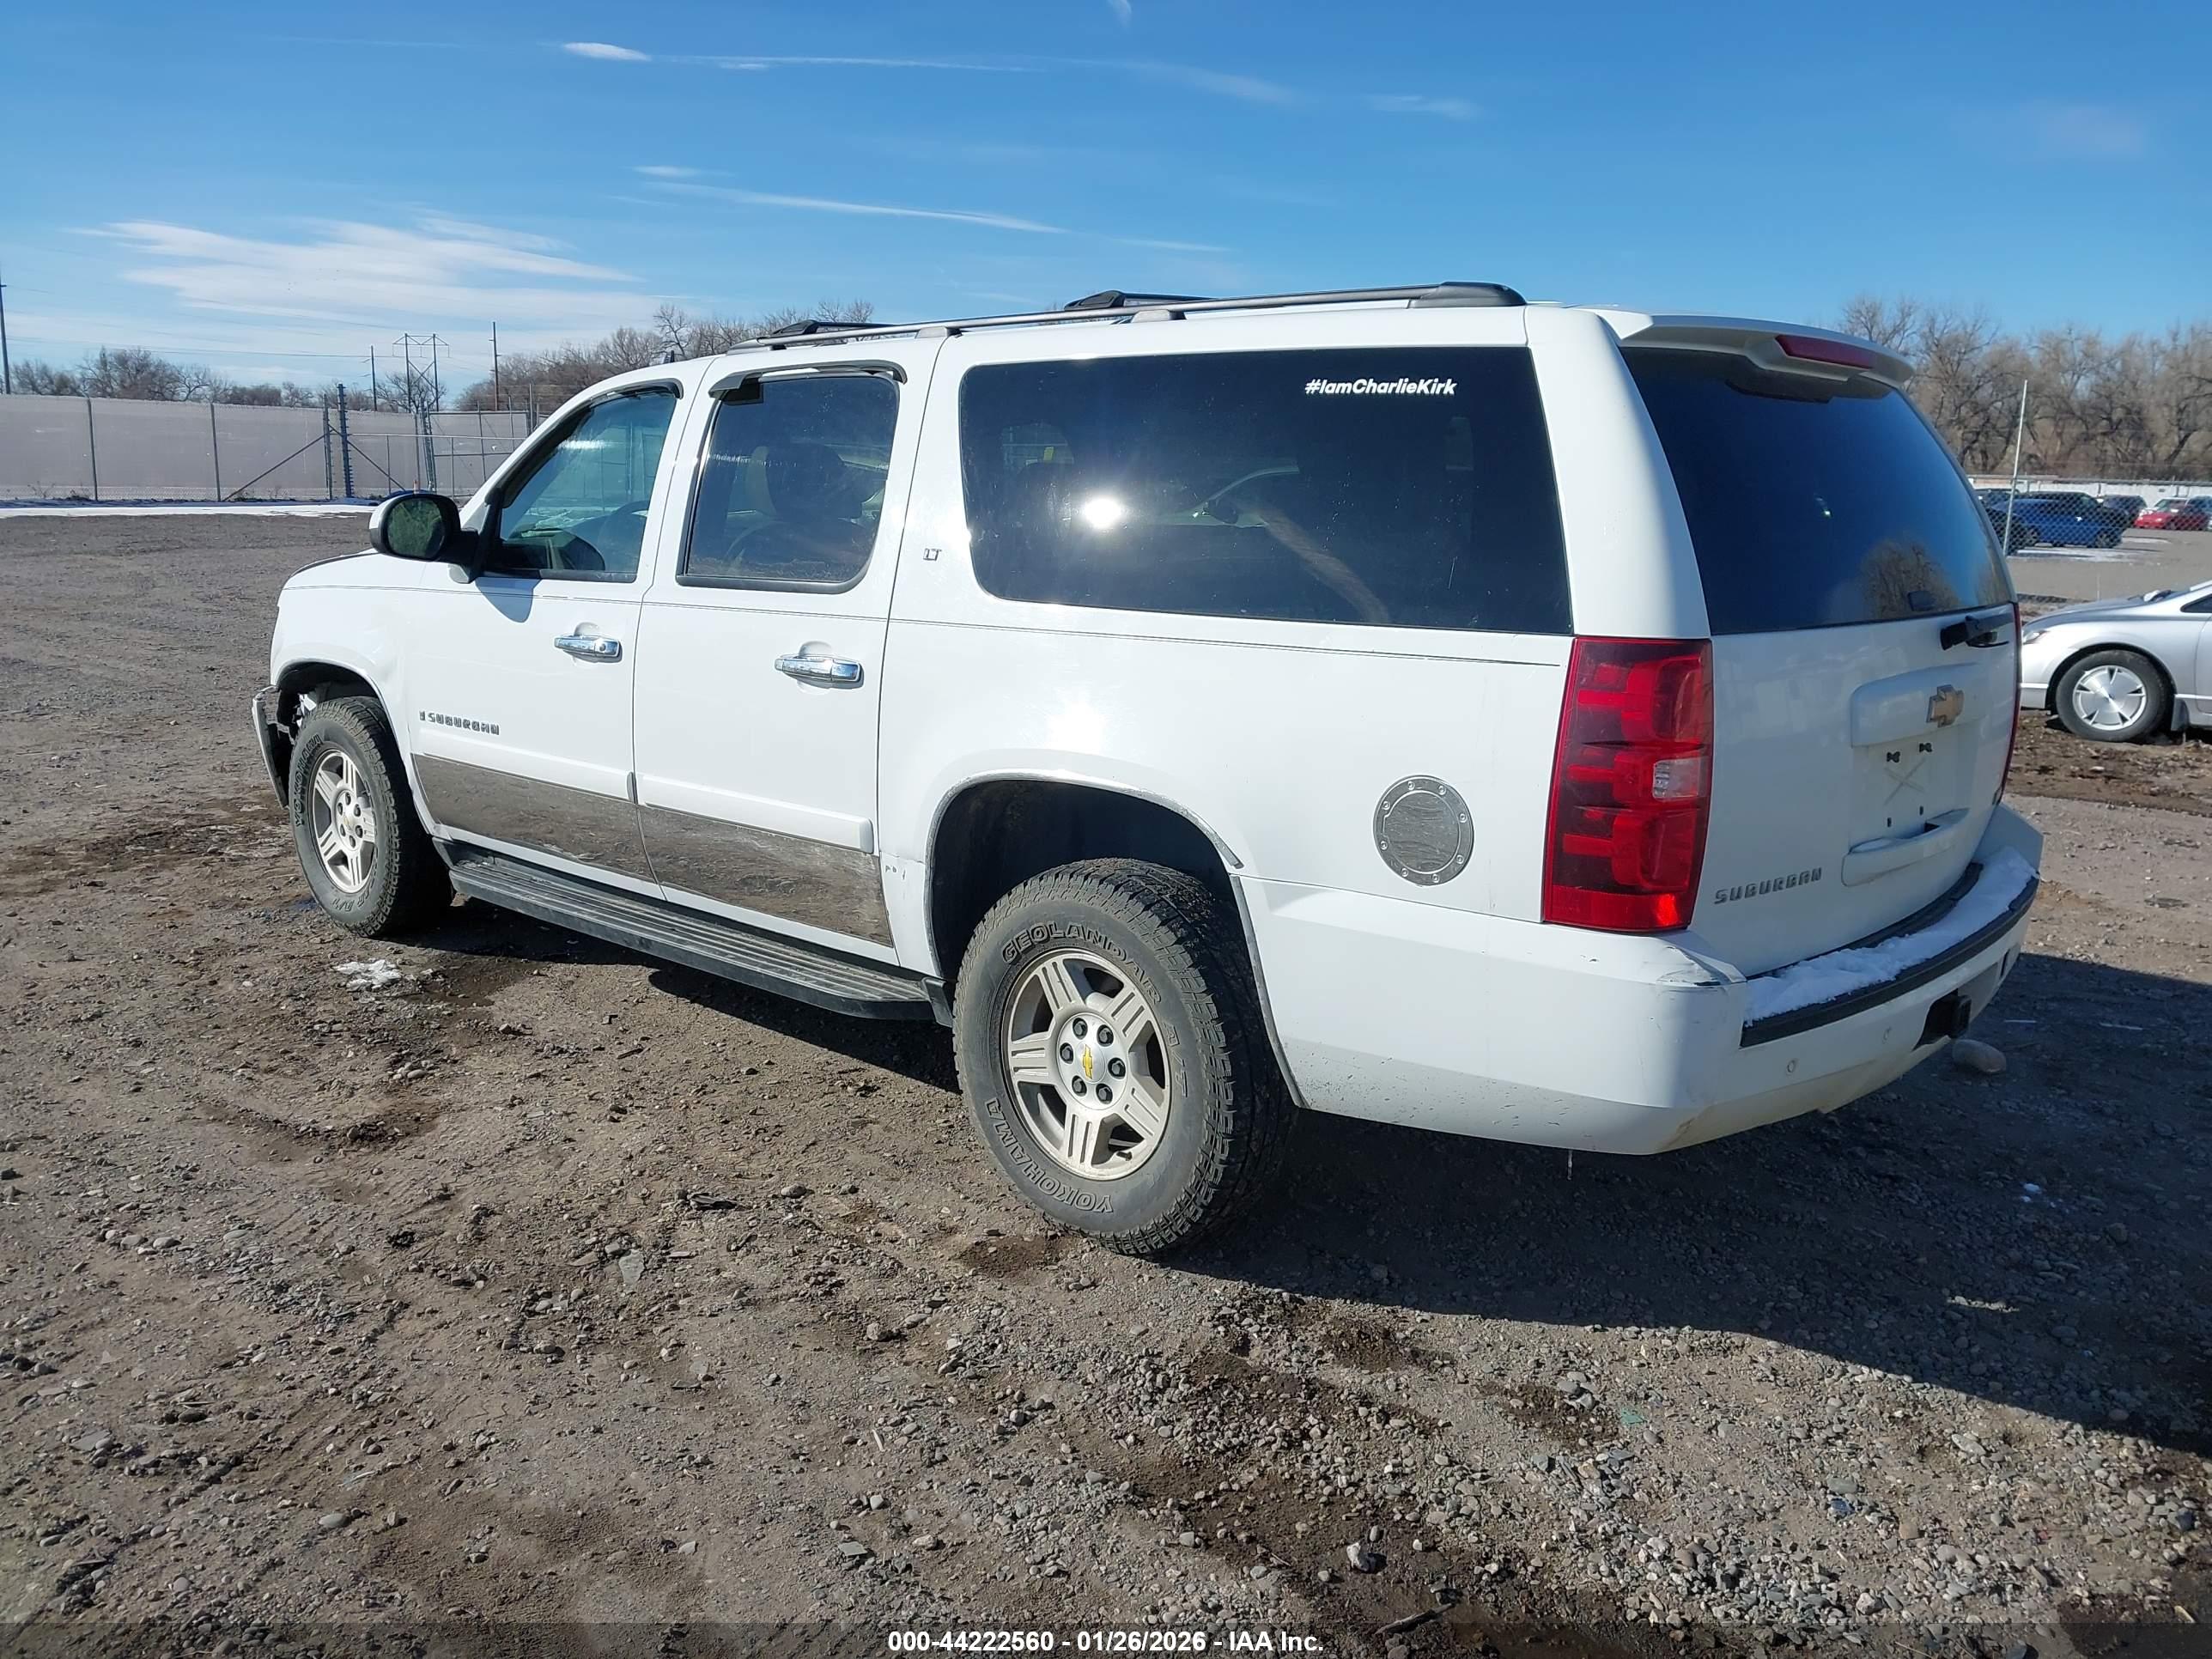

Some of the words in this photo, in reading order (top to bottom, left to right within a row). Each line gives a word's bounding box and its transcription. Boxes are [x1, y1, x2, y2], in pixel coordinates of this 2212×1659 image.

[1304, 378, 1457, 395] #IamCharlieKirk
[922, 548, 942, 562] LT
[428, 712, 500, 736] SUBURBAN
[1714, 866, 1822, 905] SUBURBAN
[985, 1097, 1114, 1212] YOKOHAMA
